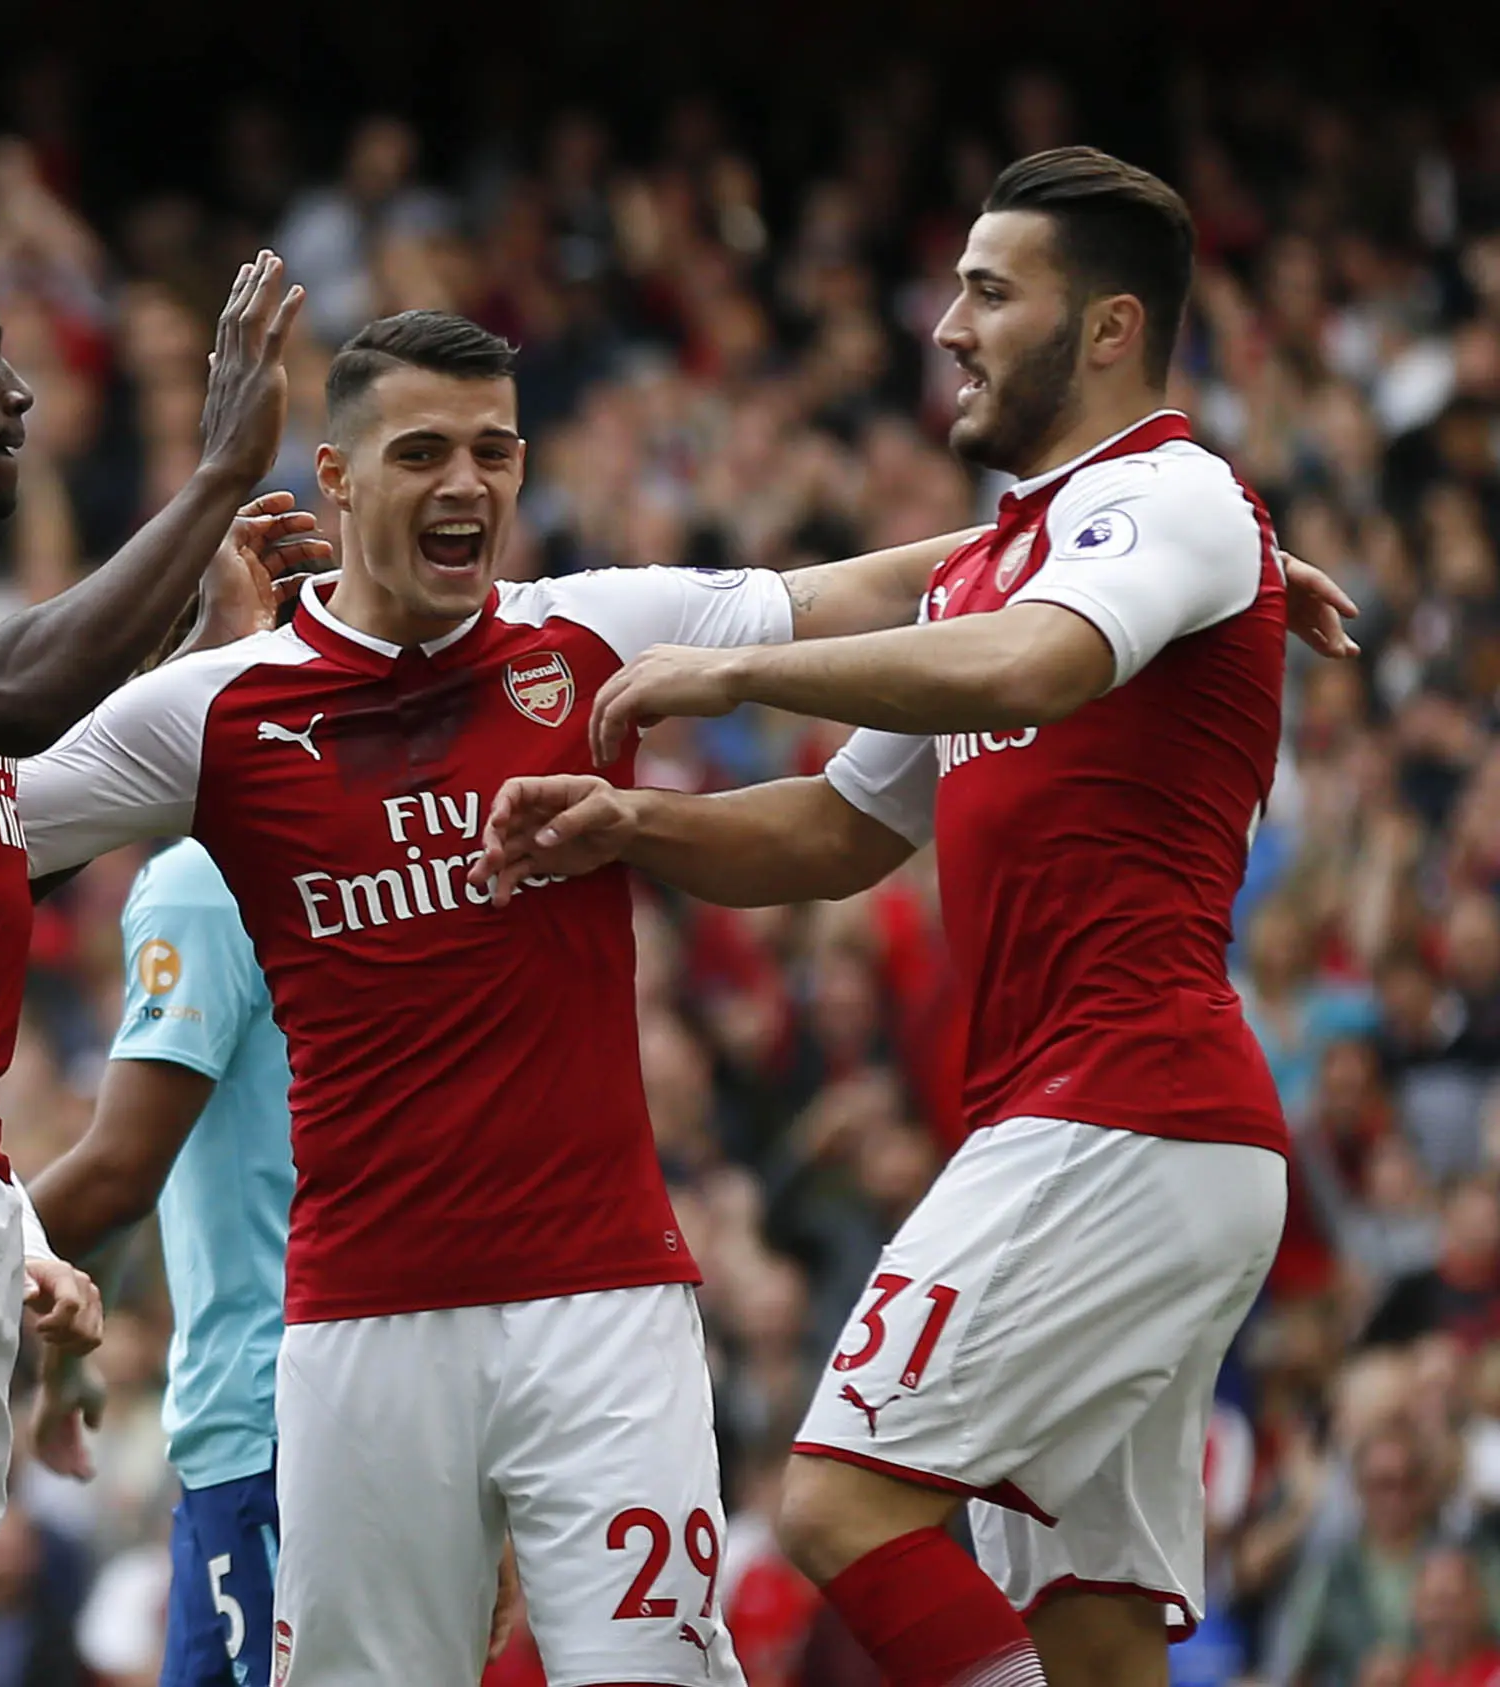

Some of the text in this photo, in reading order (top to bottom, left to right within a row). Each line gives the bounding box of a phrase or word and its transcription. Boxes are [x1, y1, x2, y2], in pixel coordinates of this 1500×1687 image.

[511, 660, 561, 684] Arsenal
[382, 791, 479, 843] Fly
[293, 846, 568, 939] Emira
[832, 1272, 960, 1391] 31
[208, 1553, 245, 1659] 5
[605, 1507, 720, 1620] 29
